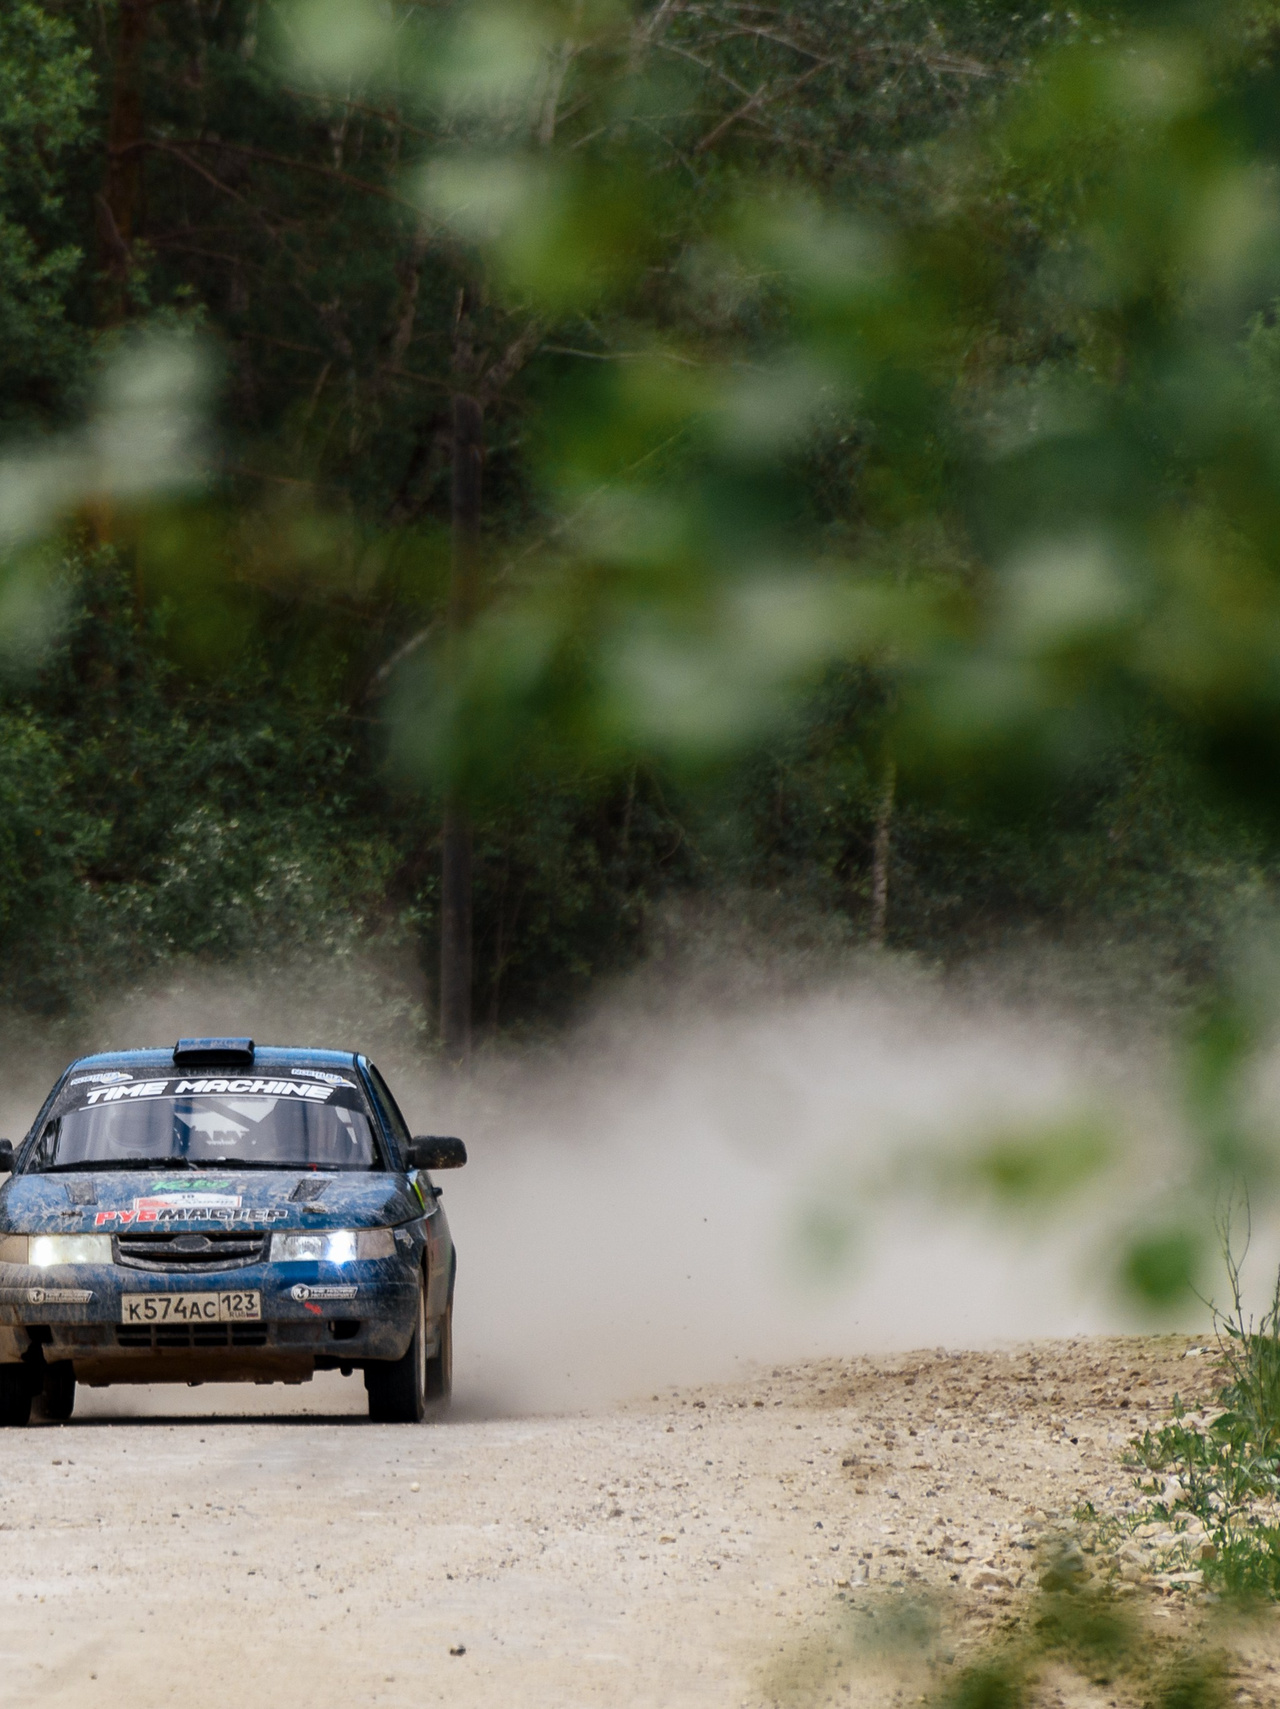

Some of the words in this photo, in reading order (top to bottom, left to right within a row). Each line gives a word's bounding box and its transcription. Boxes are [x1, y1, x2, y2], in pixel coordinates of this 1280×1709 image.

[87, 1081, 169, 1104] TIME
[175, 1079, 334, 1100] MACHINE
[222, 1294, 256, 1311] 123
